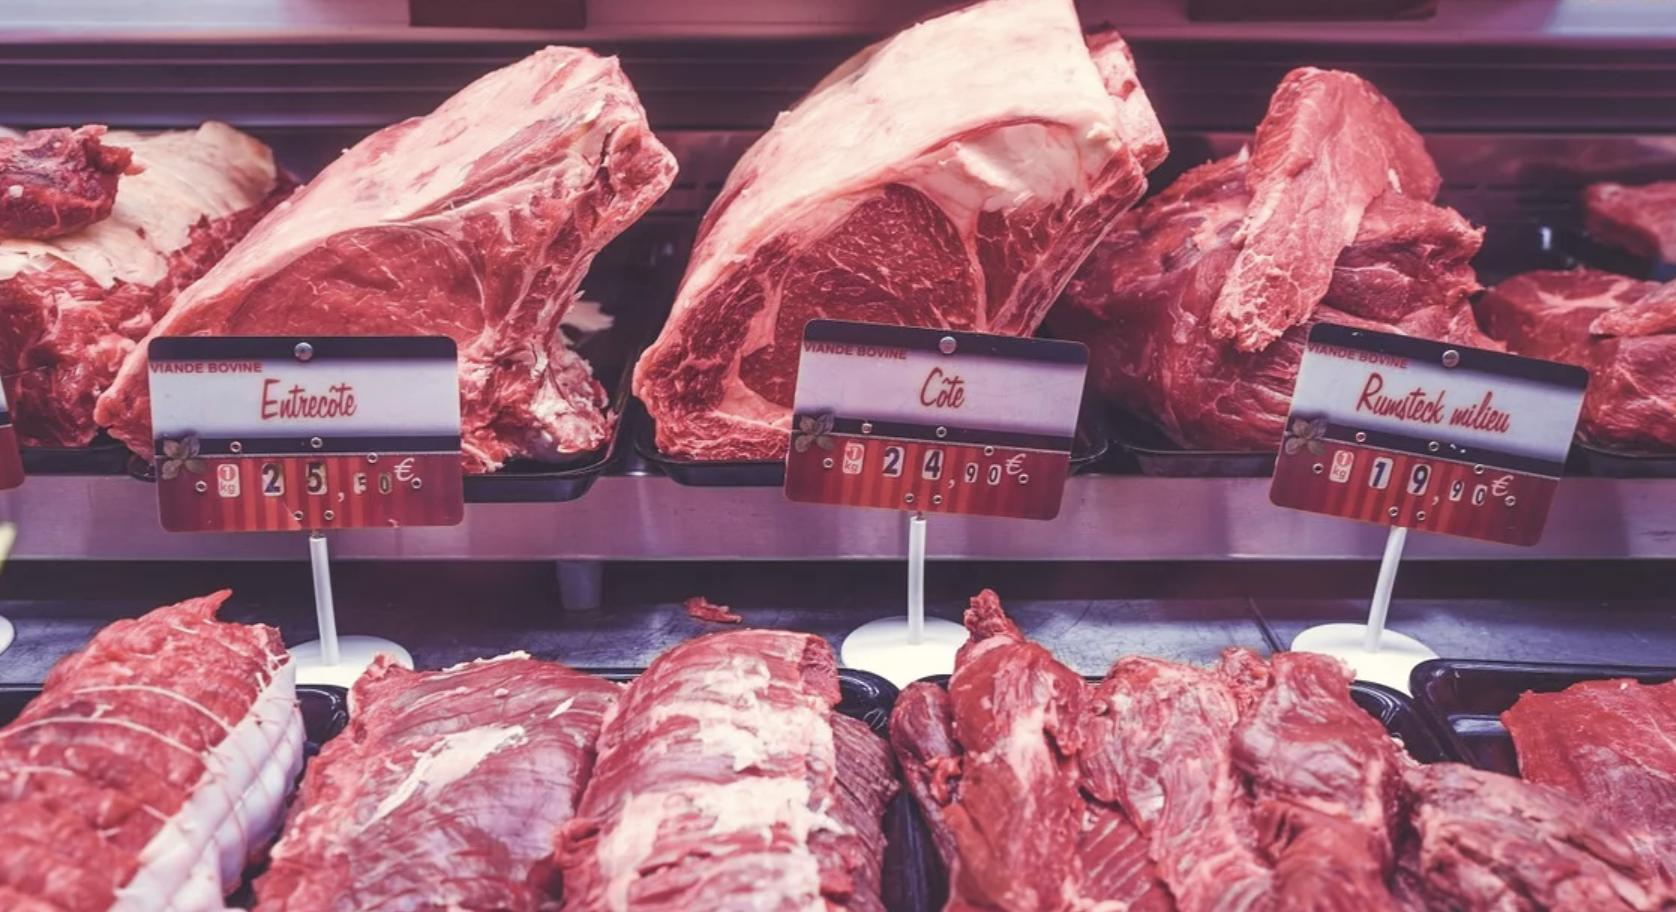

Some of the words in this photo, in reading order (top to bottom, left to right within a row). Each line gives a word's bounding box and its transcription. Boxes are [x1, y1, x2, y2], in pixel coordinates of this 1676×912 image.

[150, 362, 204, 374] VIANDE
[207, 362, 263, 374] BOVINE
[803, 342, 853, 356] VIANDE
[857, 346, 907, 360] BOVINE
[1307, 342, 1355, 360] VIANDE
[1358, 351, 1407, 369] BOVINE
[260, 378, 358, 420] Entrecôte
[919, 366, 966, 409] Côte
[1355, 372, 1445, 423] Rumsteck
[1449, 390, 1512, 433] milieu
